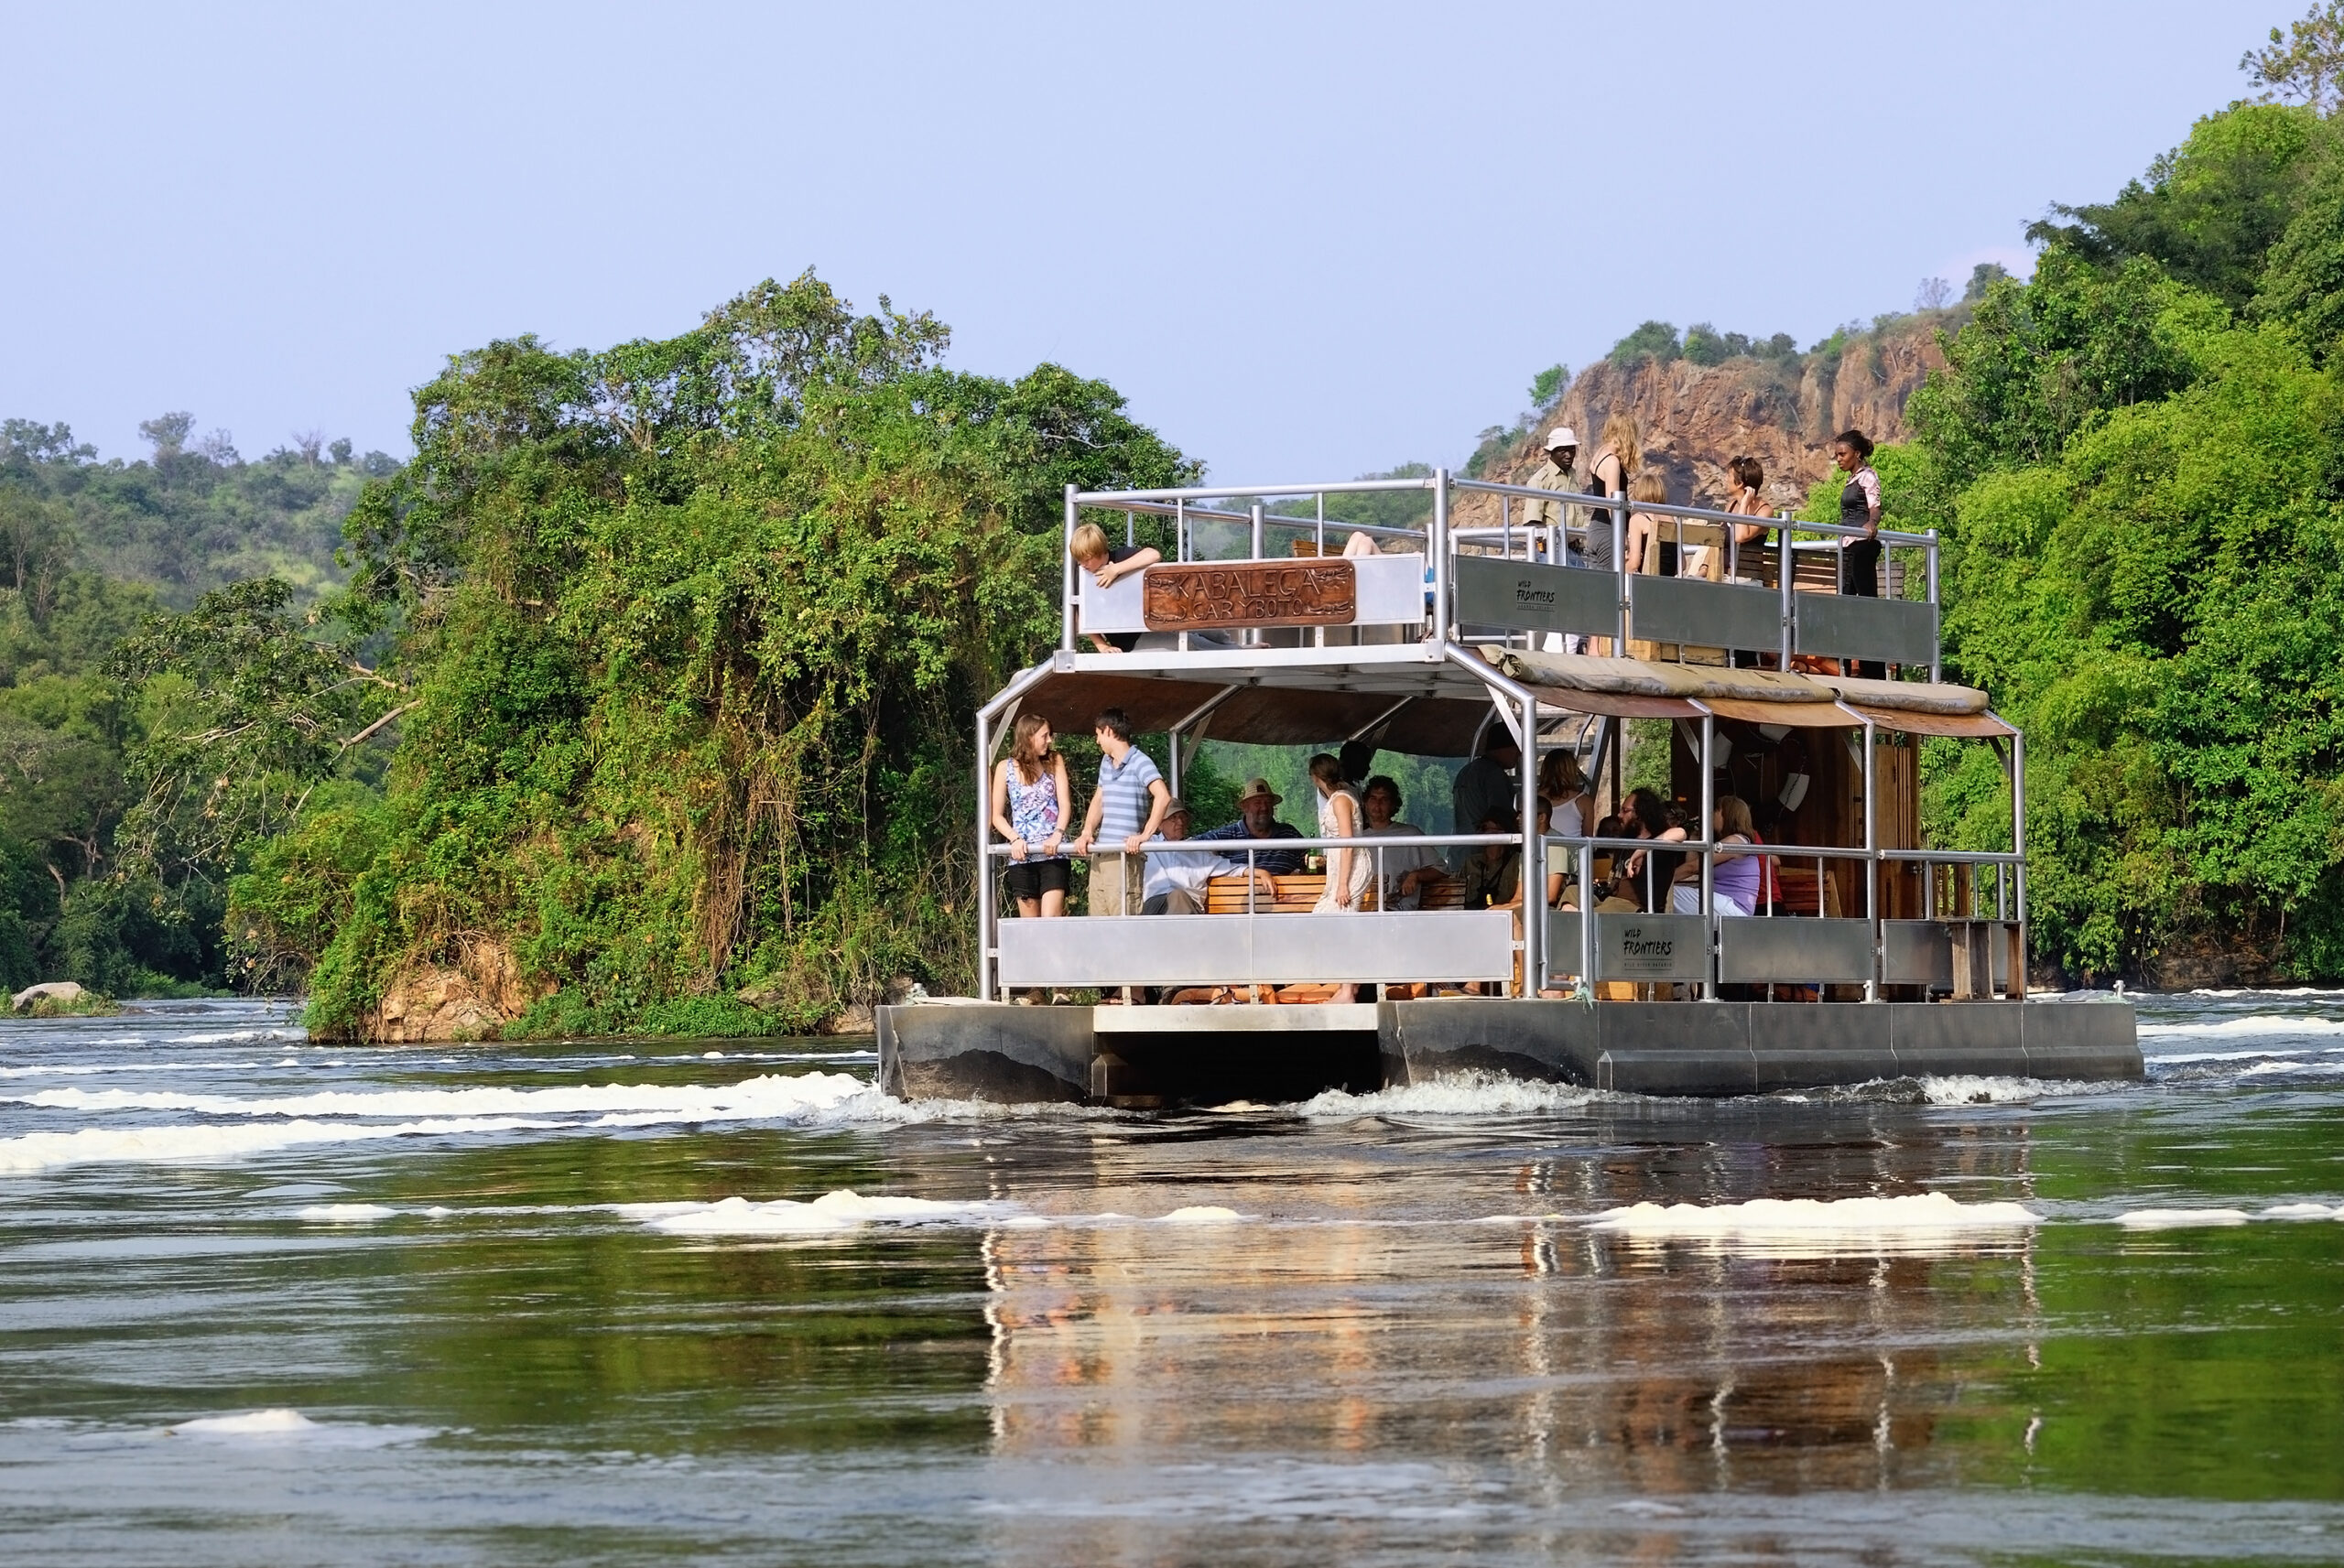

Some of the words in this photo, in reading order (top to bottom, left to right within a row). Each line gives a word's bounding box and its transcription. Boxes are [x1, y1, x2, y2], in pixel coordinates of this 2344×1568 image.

[1176, 569, 1320, 600] KABALEGA
[1516, 589, 1555, 602] FRONTIERS
[1624, 928, 1641, 938] WILD
[1623, 940, 1672, 956] FRONTIERS
